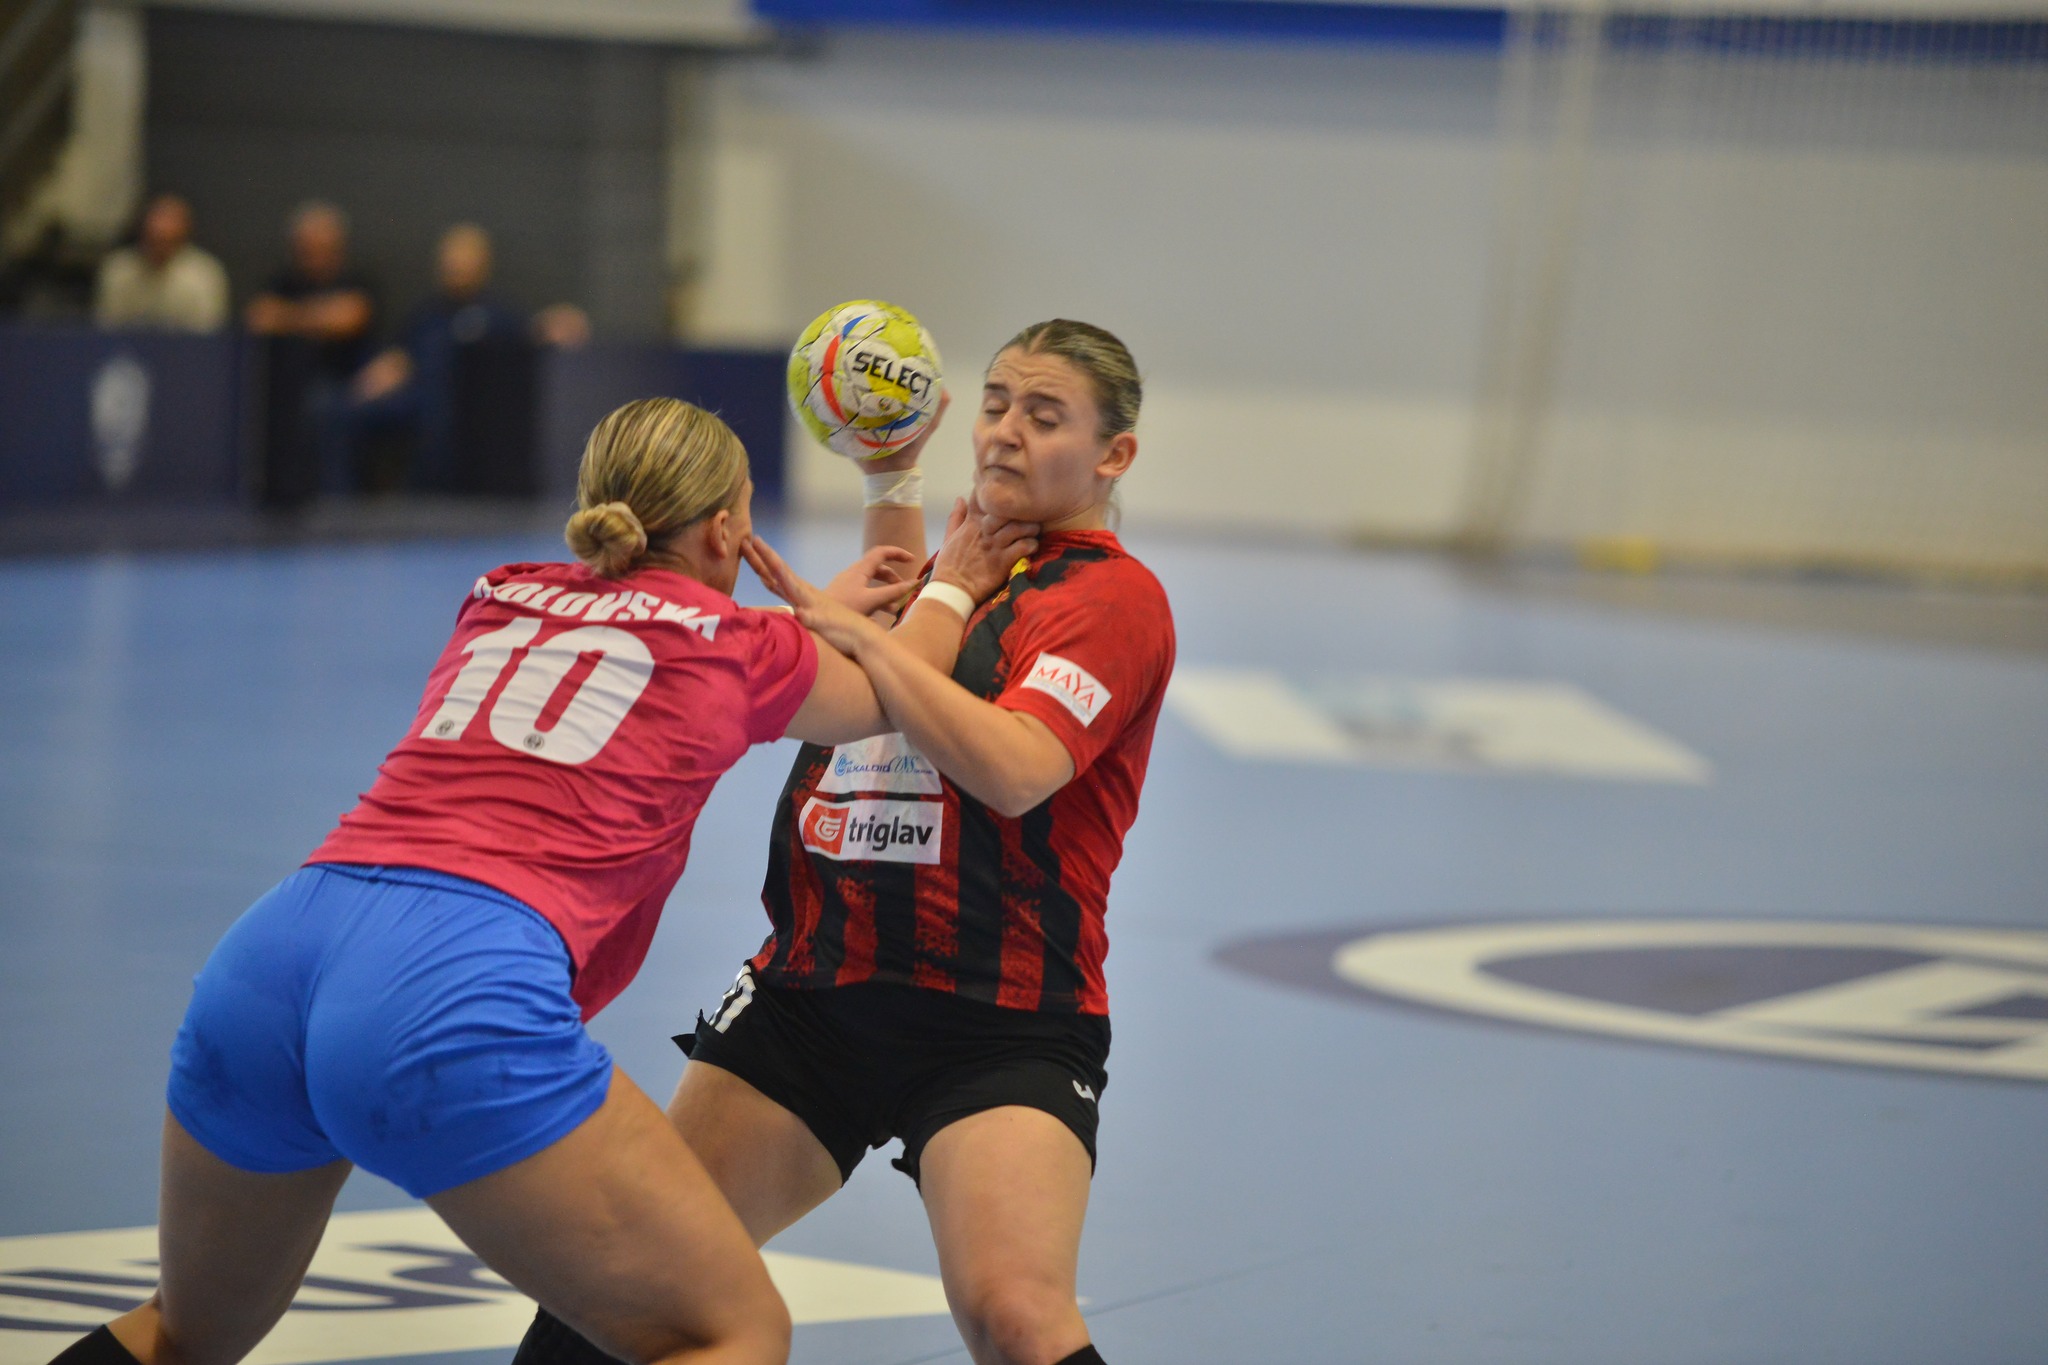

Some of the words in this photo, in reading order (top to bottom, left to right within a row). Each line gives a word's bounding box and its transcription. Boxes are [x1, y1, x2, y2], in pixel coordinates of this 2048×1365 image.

[853, 351, 931, 399] SELECT
[420, 617, 655, 764] 10
[1034, 666, 1095, 710] MAYA
[849, 815, 933, 851] triglav
